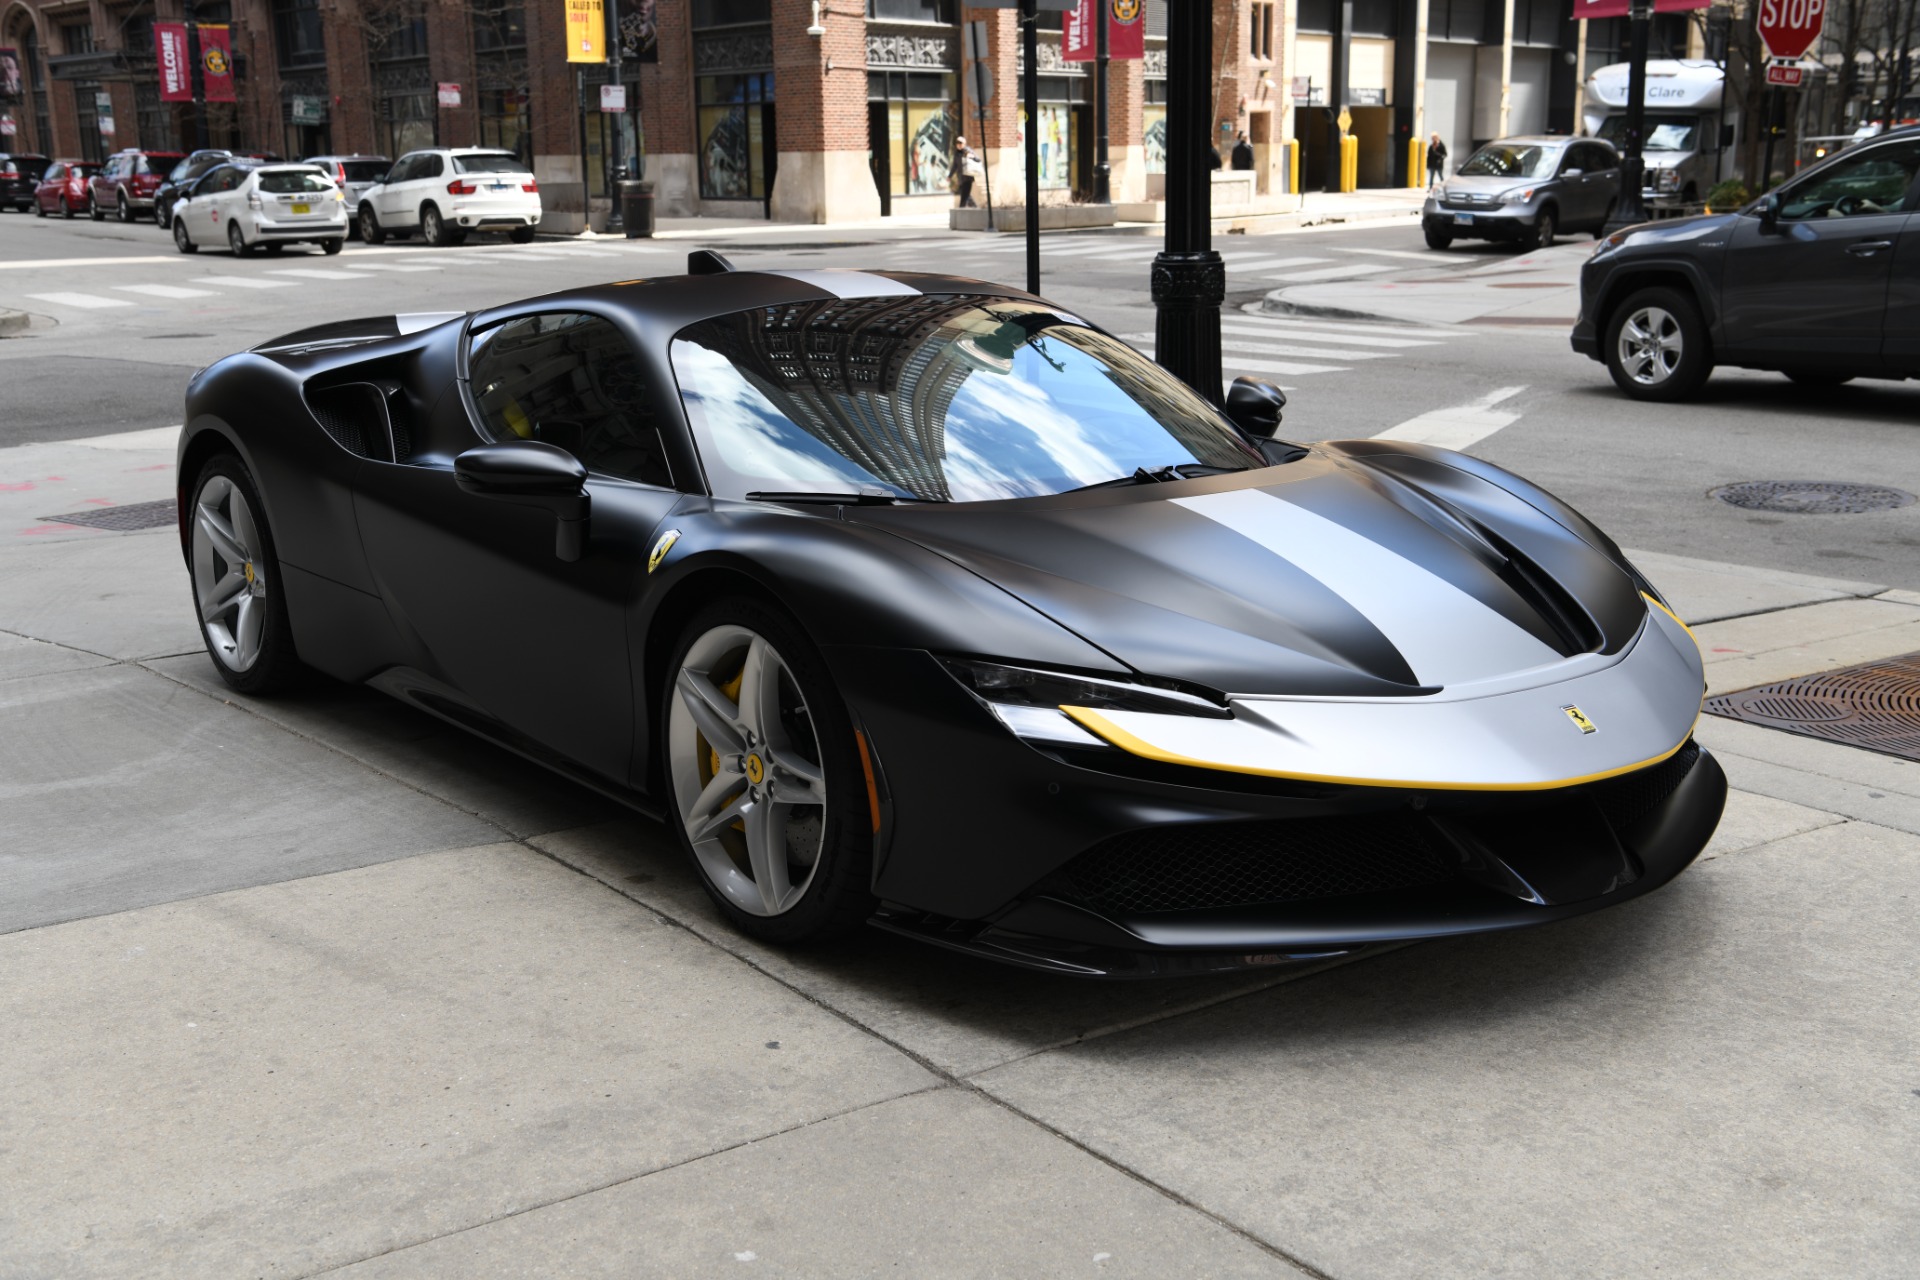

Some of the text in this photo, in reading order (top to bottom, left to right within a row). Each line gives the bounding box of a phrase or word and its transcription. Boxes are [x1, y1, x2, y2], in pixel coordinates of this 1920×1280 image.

[1068, 0, 1082, 52] WELC
[1762, 0, 1823, 29] STOP
[161, 31, 178, 93] WELCOME
[1771, 68, 1799, 81] ALL WAY
[1648, 87, 1685, 97] Clare
